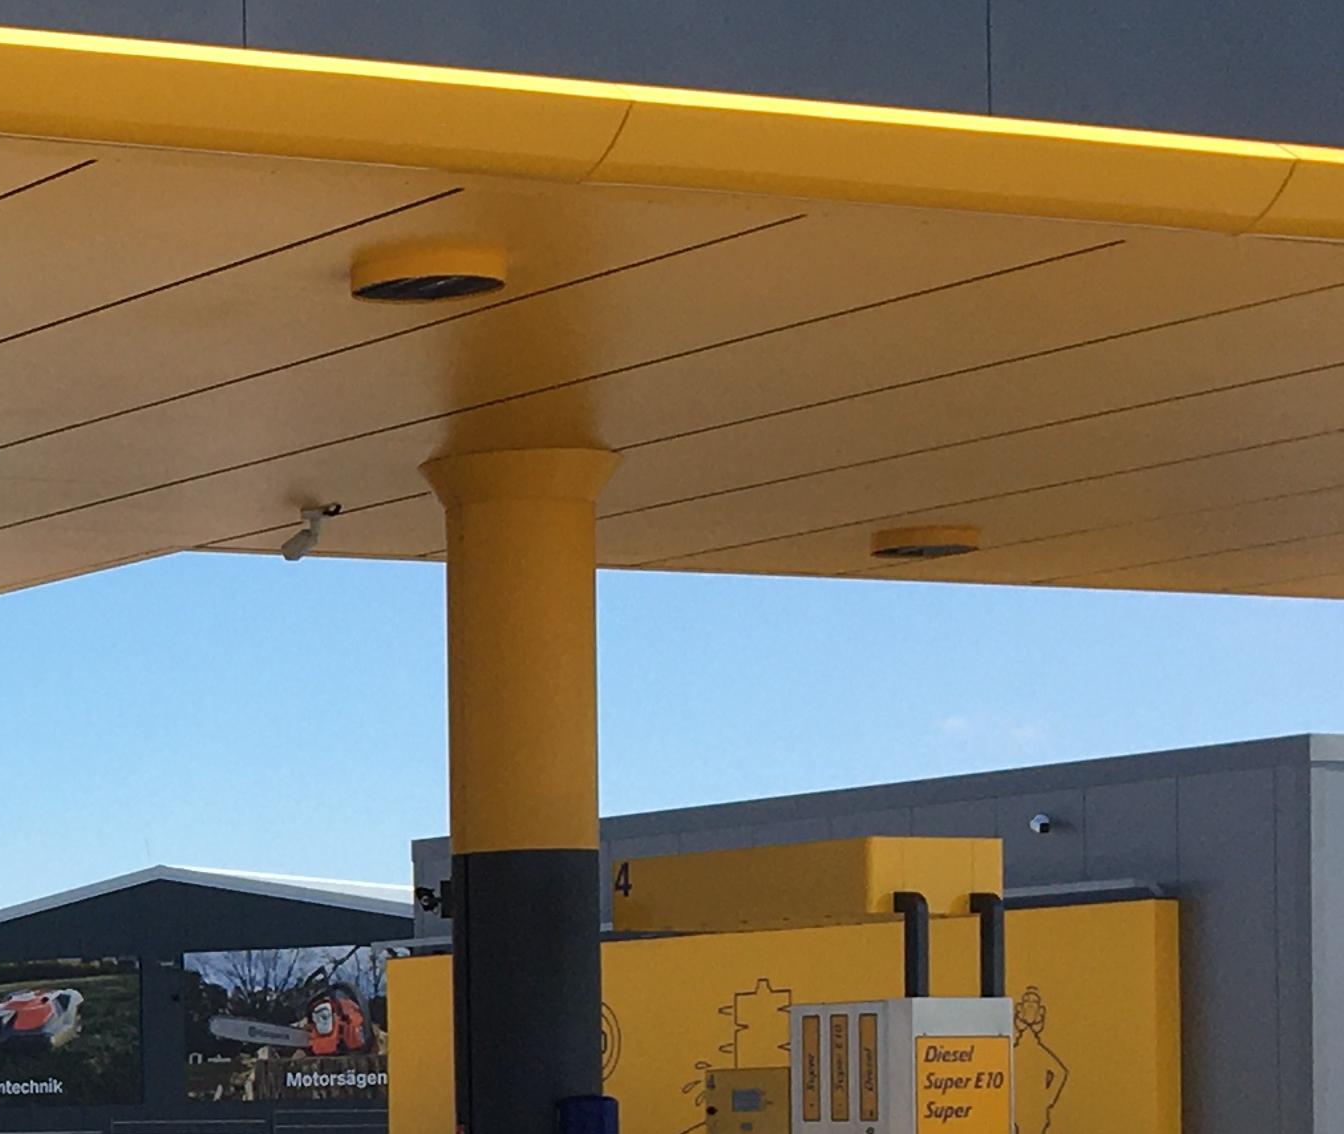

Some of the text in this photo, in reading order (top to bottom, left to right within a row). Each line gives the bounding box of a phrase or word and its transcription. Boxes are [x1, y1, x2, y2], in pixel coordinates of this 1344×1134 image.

[615, 861, 633, 897] 4
[923, 1044, 975, 1063] Diesel
[286, 1069, 388, 1088] Motorsägen
[923, 1071, 1004, 1095] Super E10
[923, 1101, 972, 1124] Super
